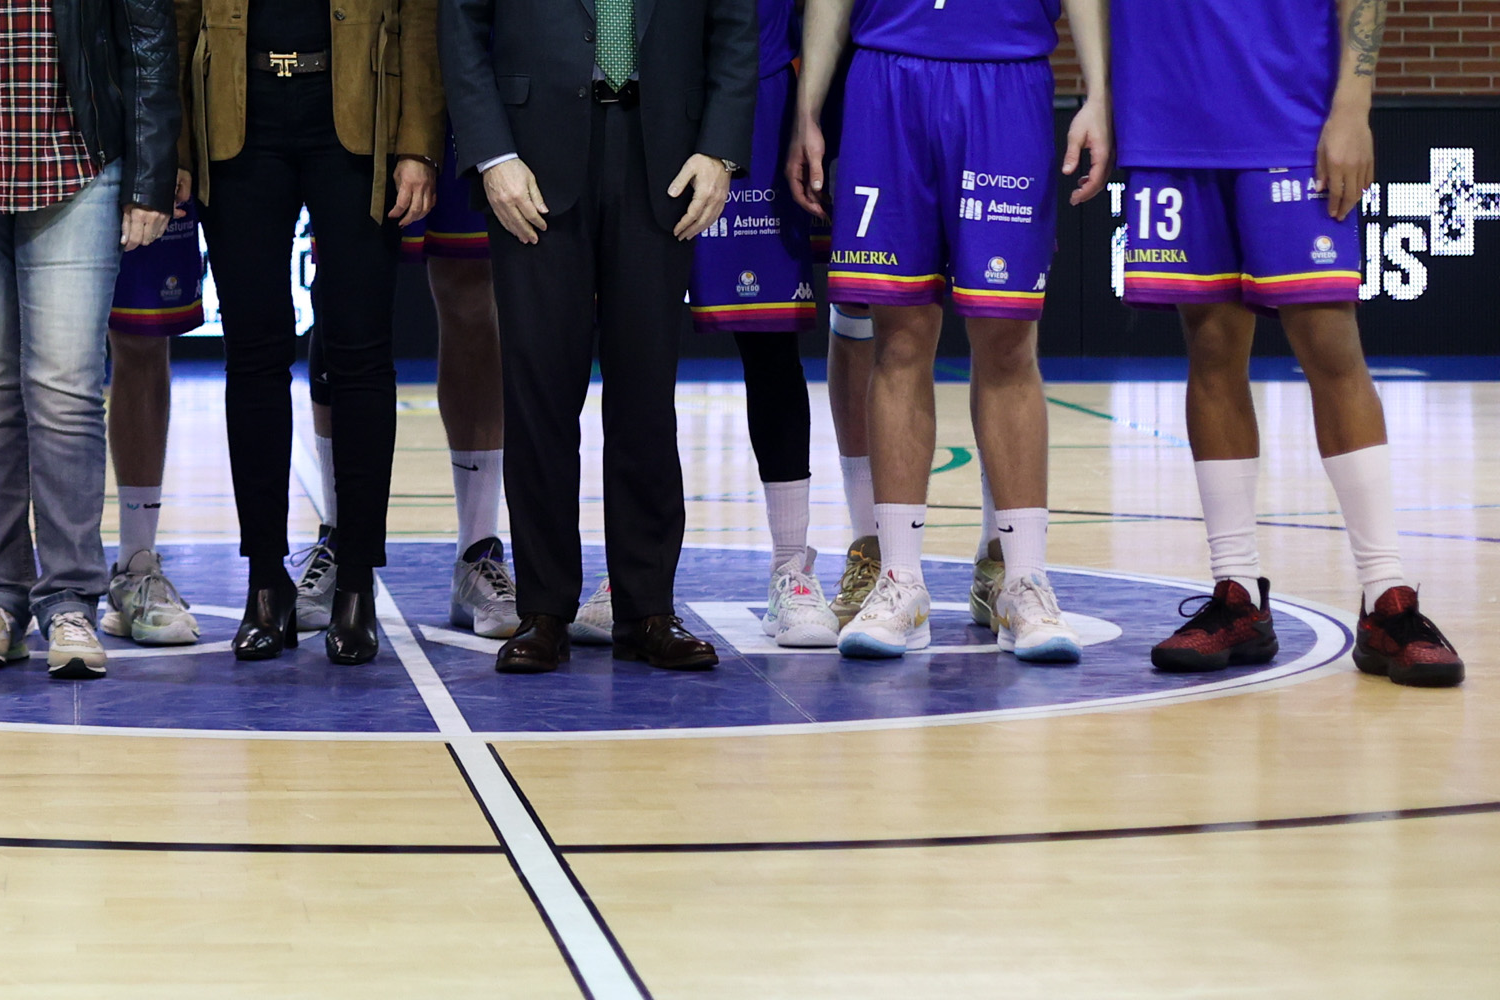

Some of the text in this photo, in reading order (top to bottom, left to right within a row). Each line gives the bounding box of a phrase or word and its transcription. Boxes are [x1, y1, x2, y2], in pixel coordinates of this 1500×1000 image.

[854, 186, 879, 238] 7
[987, 199, 1033, 216] Asturias
[1134, 187, 1183, 241] 13
[733, 215, 780, 228] Asturias
[829, 250, 899, 266] ALIMERKA
[1124, 248, 1188, 263] ALIMERKA
